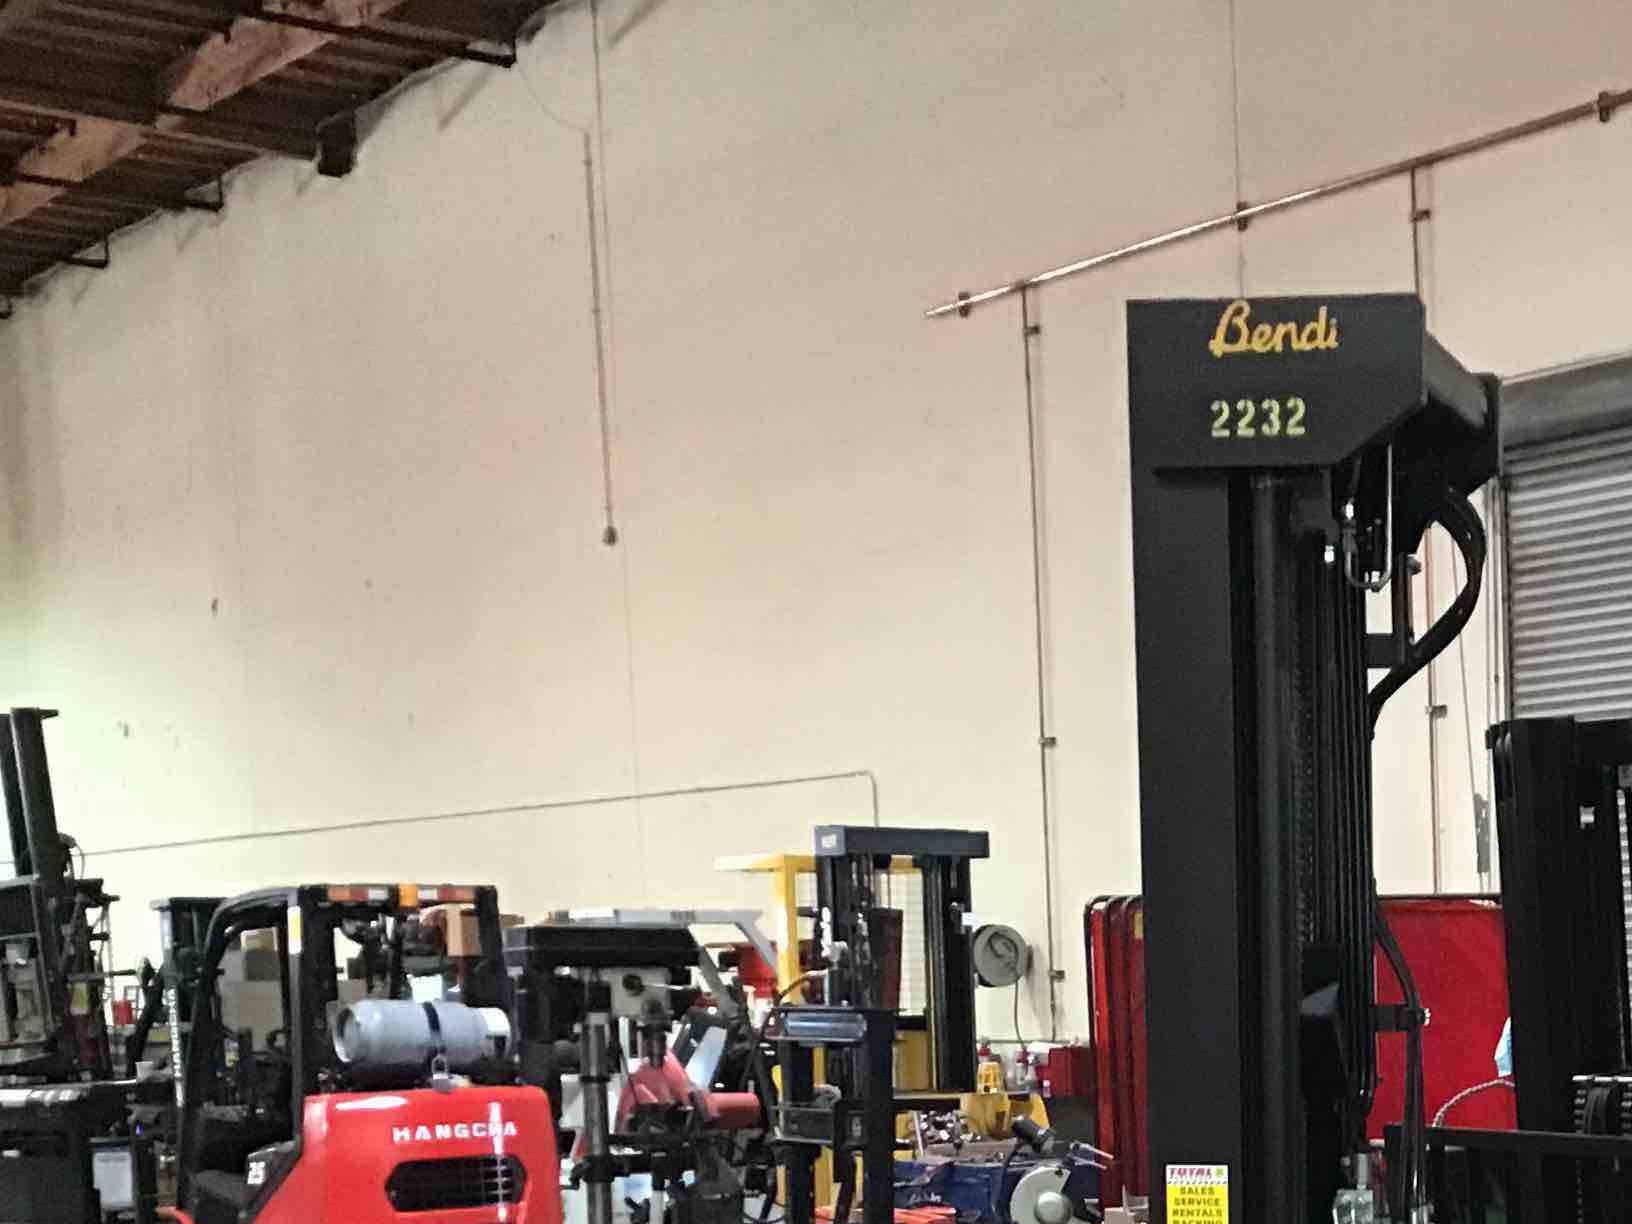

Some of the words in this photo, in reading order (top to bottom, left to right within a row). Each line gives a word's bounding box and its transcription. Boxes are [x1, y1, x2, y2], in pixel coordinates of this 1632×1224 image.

[1208, 300, 1340, 358] Bendi
[1210, 397, 1307, 438] 2232
[1180, 1186, 1215, 1195] SALES
[1174, 1198, 1220, 1206] SERVICE
[1172, 1208, 1222, 1217] RENTALS
